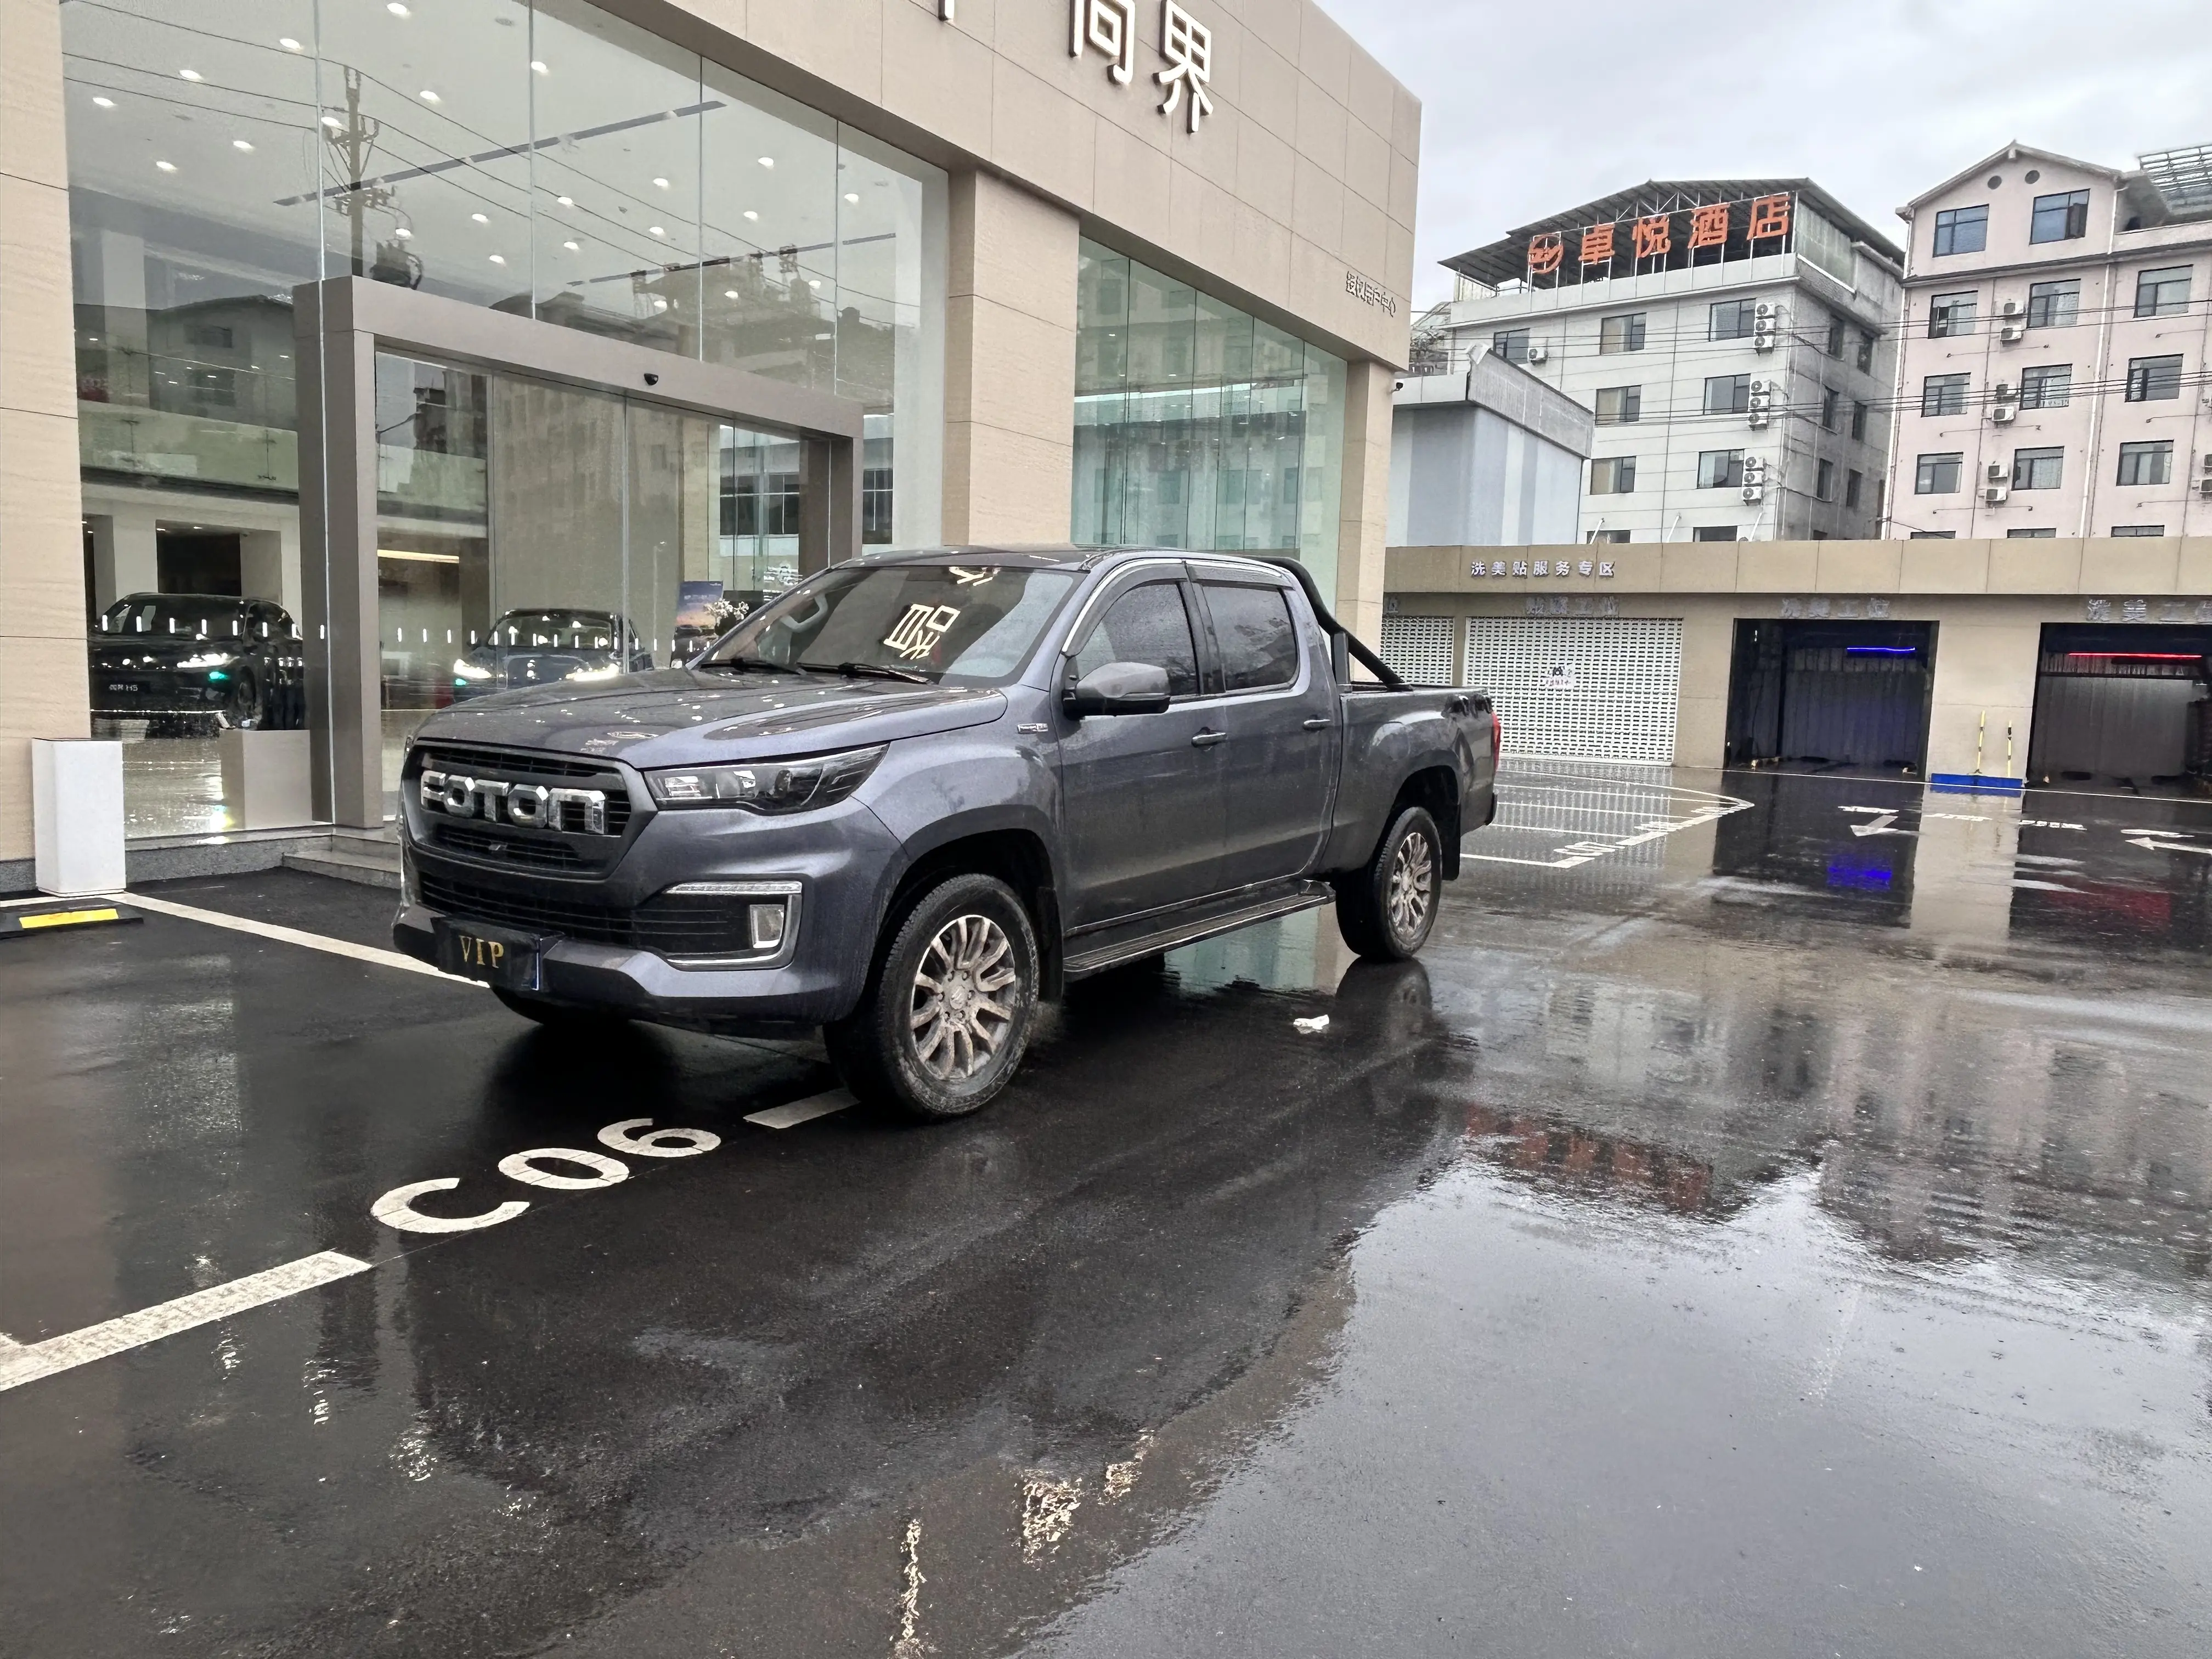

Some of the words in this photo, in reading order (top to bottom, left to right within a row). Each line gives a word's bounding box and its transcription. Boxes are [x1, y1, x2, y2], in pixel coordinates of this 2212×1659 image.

[1471, 560, 1615, 577] 洗美贴服务专区
[420, 770, 605, 834] FOTON
[459, 935, 504, 968] VIP
[371, 1118, 721, 1234] C06
